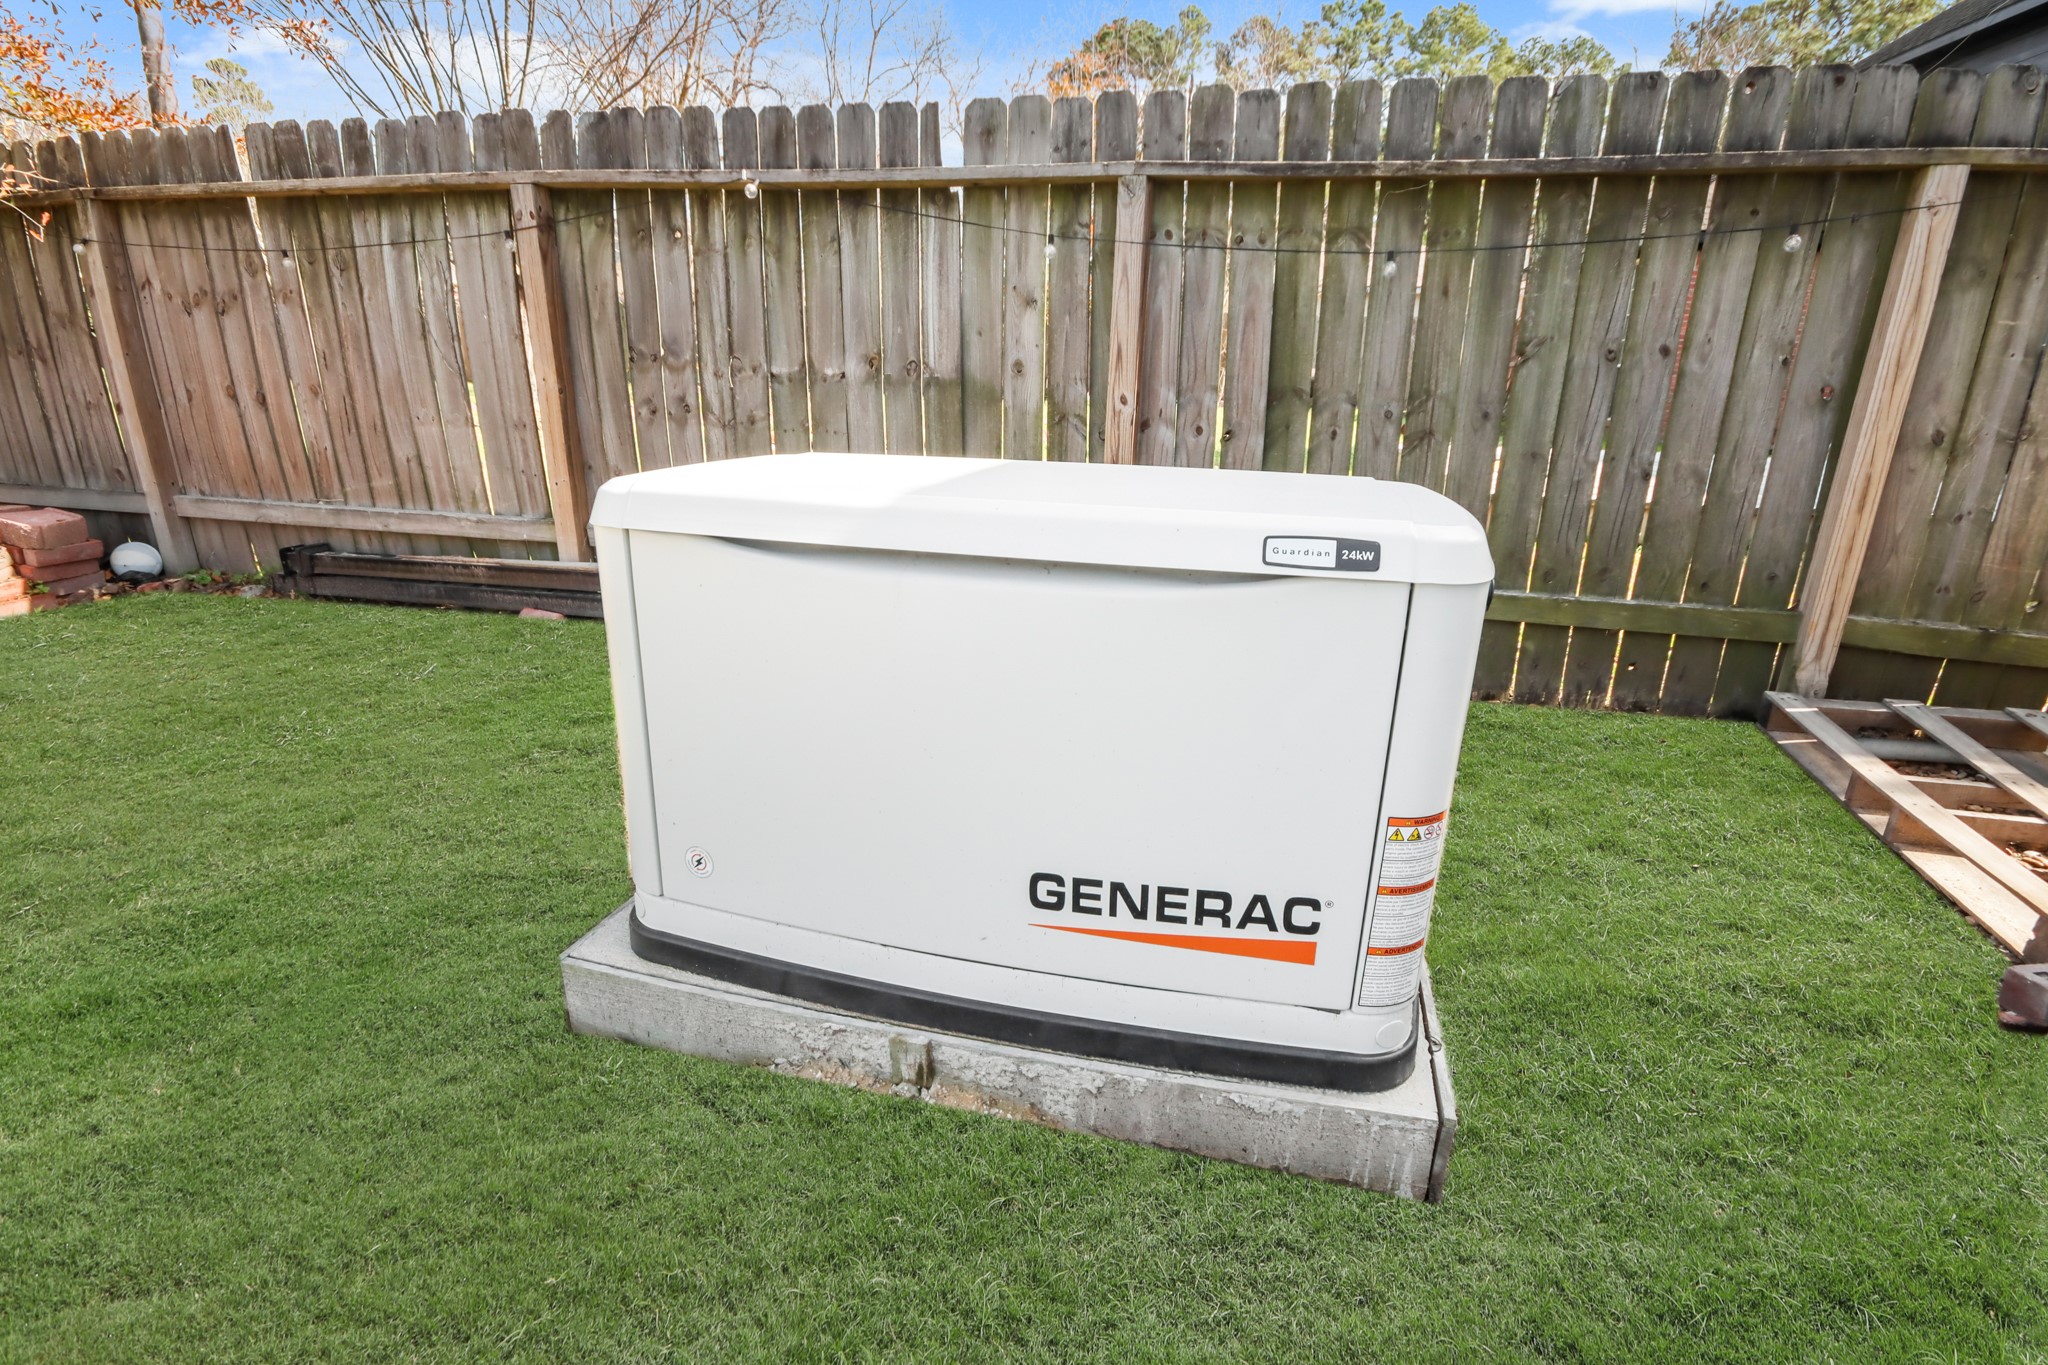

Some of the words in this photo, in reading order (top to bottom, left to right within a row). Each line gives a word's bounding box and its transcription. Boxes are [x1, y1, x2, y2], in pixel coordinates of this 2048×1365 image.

[1272, 546, 1331, 557] Guardian
[1341, 549, 1375, 561] 24kW
[1414, 815, 1441, 825] WARNING
[1029, 872, 1322, 936] GENERAC
[1384, 942, 1420, 954] ADVERTEN
